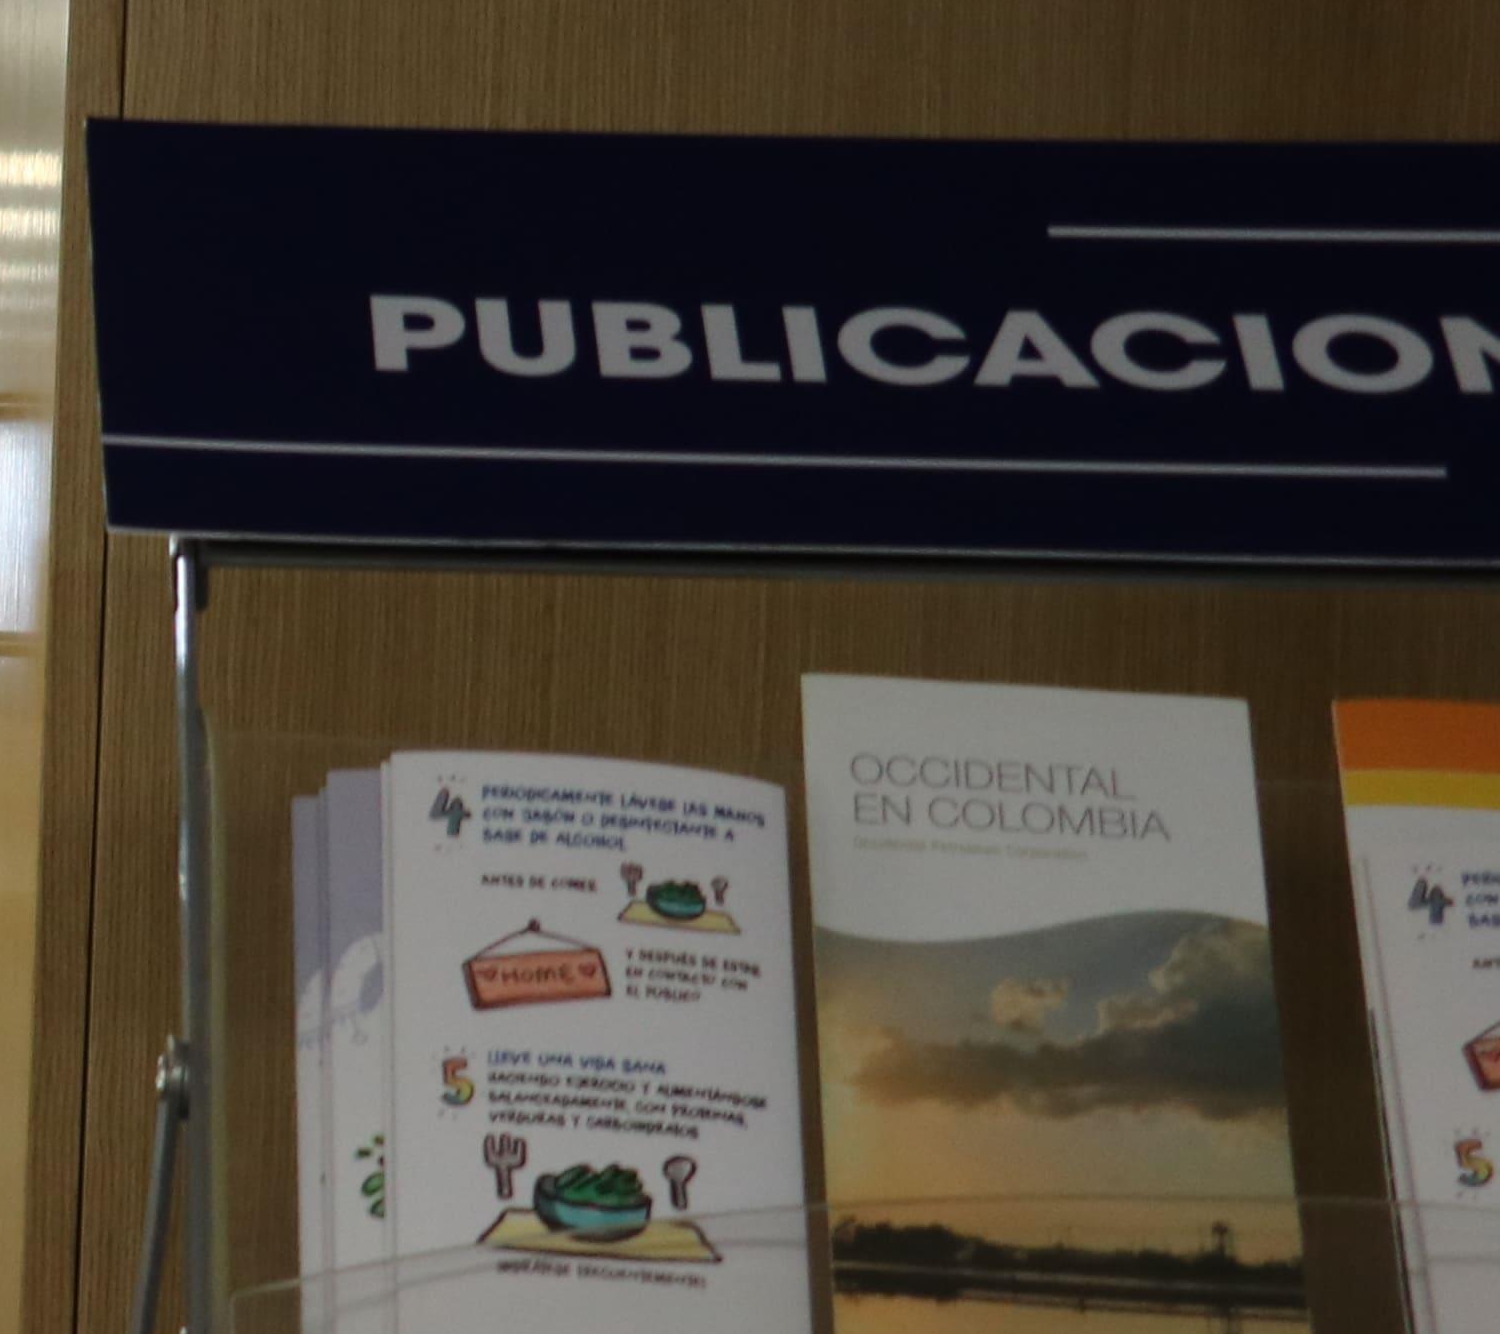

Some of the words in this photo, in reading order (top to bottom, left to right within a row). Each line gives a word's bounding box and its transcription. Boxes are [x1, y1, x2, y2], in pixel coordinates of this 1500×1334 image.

[850, 752, 1137, 801] OCCIDENTAL
[430, 786, 472, 838] 4
[714, 805, 766, 828] MANOS
[853, 791, 912, 826] EN
[928, 796, 1172, 843] COLOMBIA
[529, 829, 548, 846] DE
[1407, 877, 1455, 925] 4
[442, 1056, 475, 1107] 5
[1454, 1137, 1494, 1187] 5
